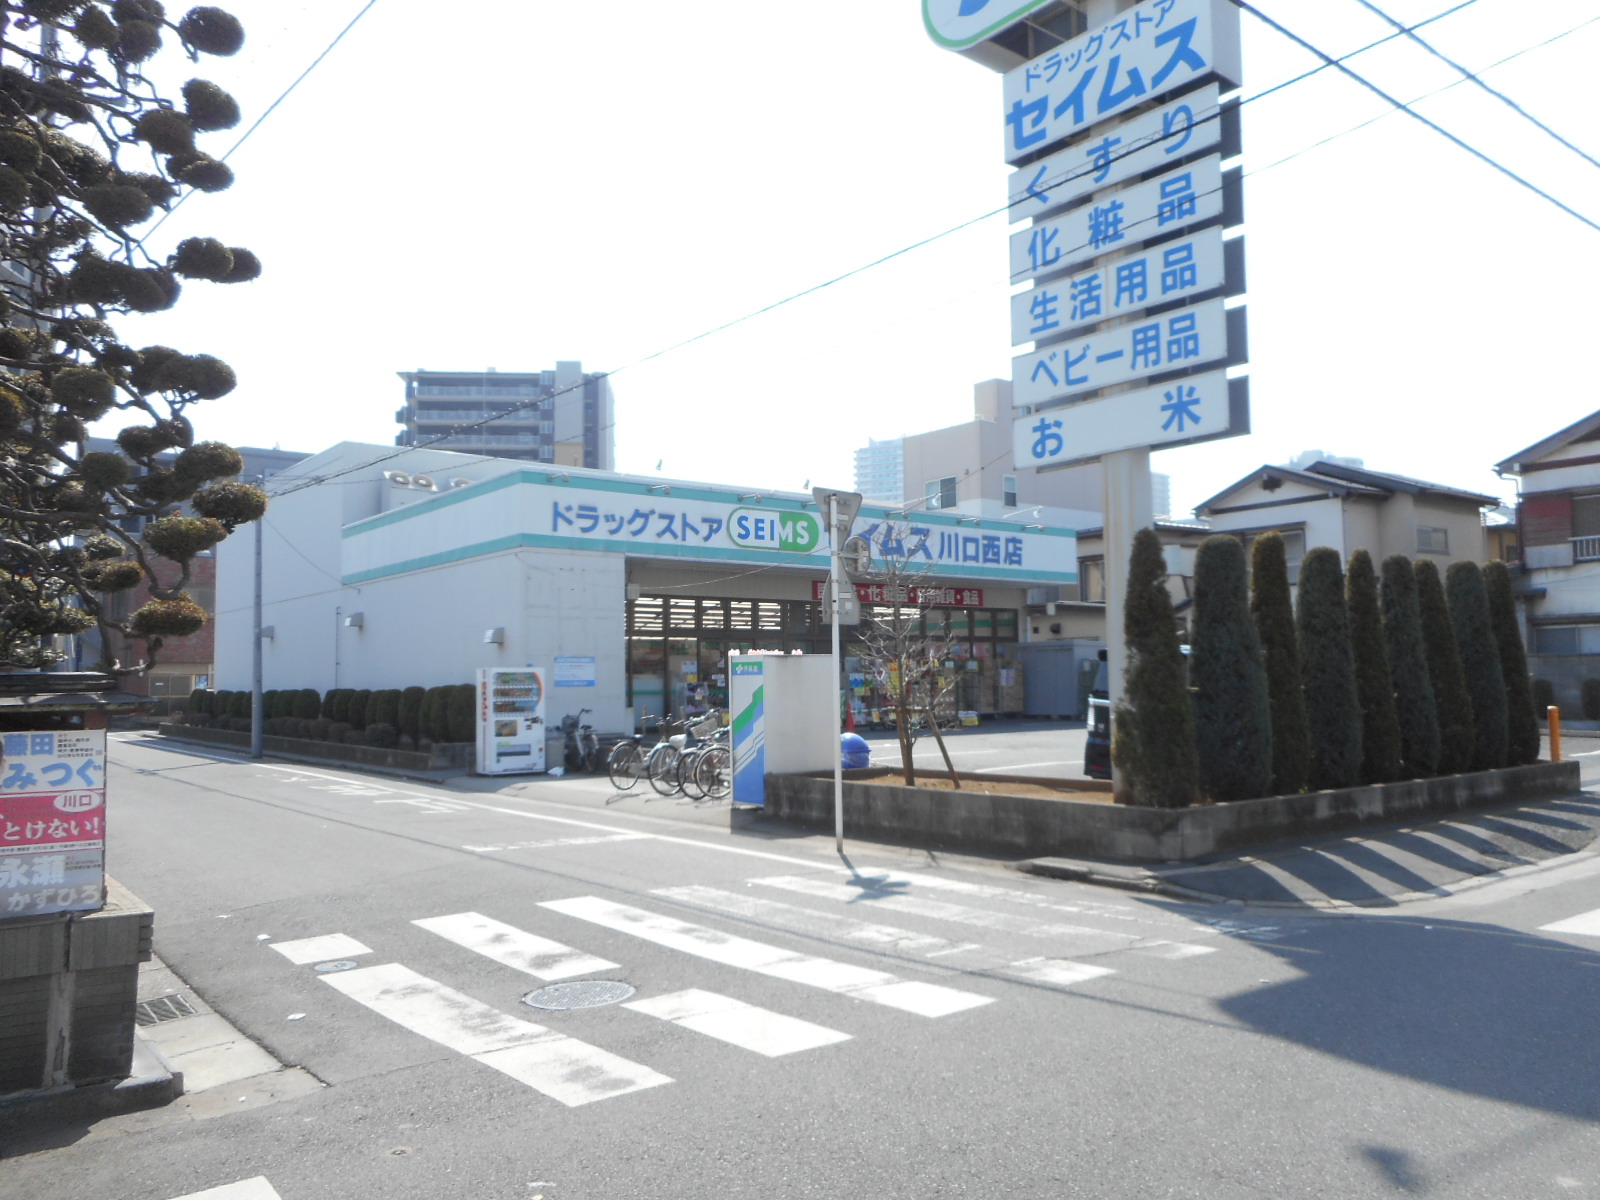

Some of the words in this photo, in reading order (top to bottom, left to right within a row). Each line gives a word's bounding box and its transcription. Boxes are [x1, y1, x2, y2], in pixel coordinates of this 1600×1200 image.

[1006, 16, 1207, 150] セイムス
[1026, 0, 1175, 93] ドラッグストア
[1026, 104, 1194, 204] くすり
[1027, 172, 1196, 272] 化粧品
[1029, 242, 1197, 334] 生活用品
[1031, 312, 1200, 387] ベビー用品
[1031, 385, 1201, 459] お米
[553, 501, 723, 542] ドラッグストア
[737, 515, 809, 545] SEIMS
[2, 758, 102, 789] みつぐ
[63, 795, 92, 808] 川口
[0, 817, 99, 840] とけない!
[7, 885, 100, 912] かずひろ
